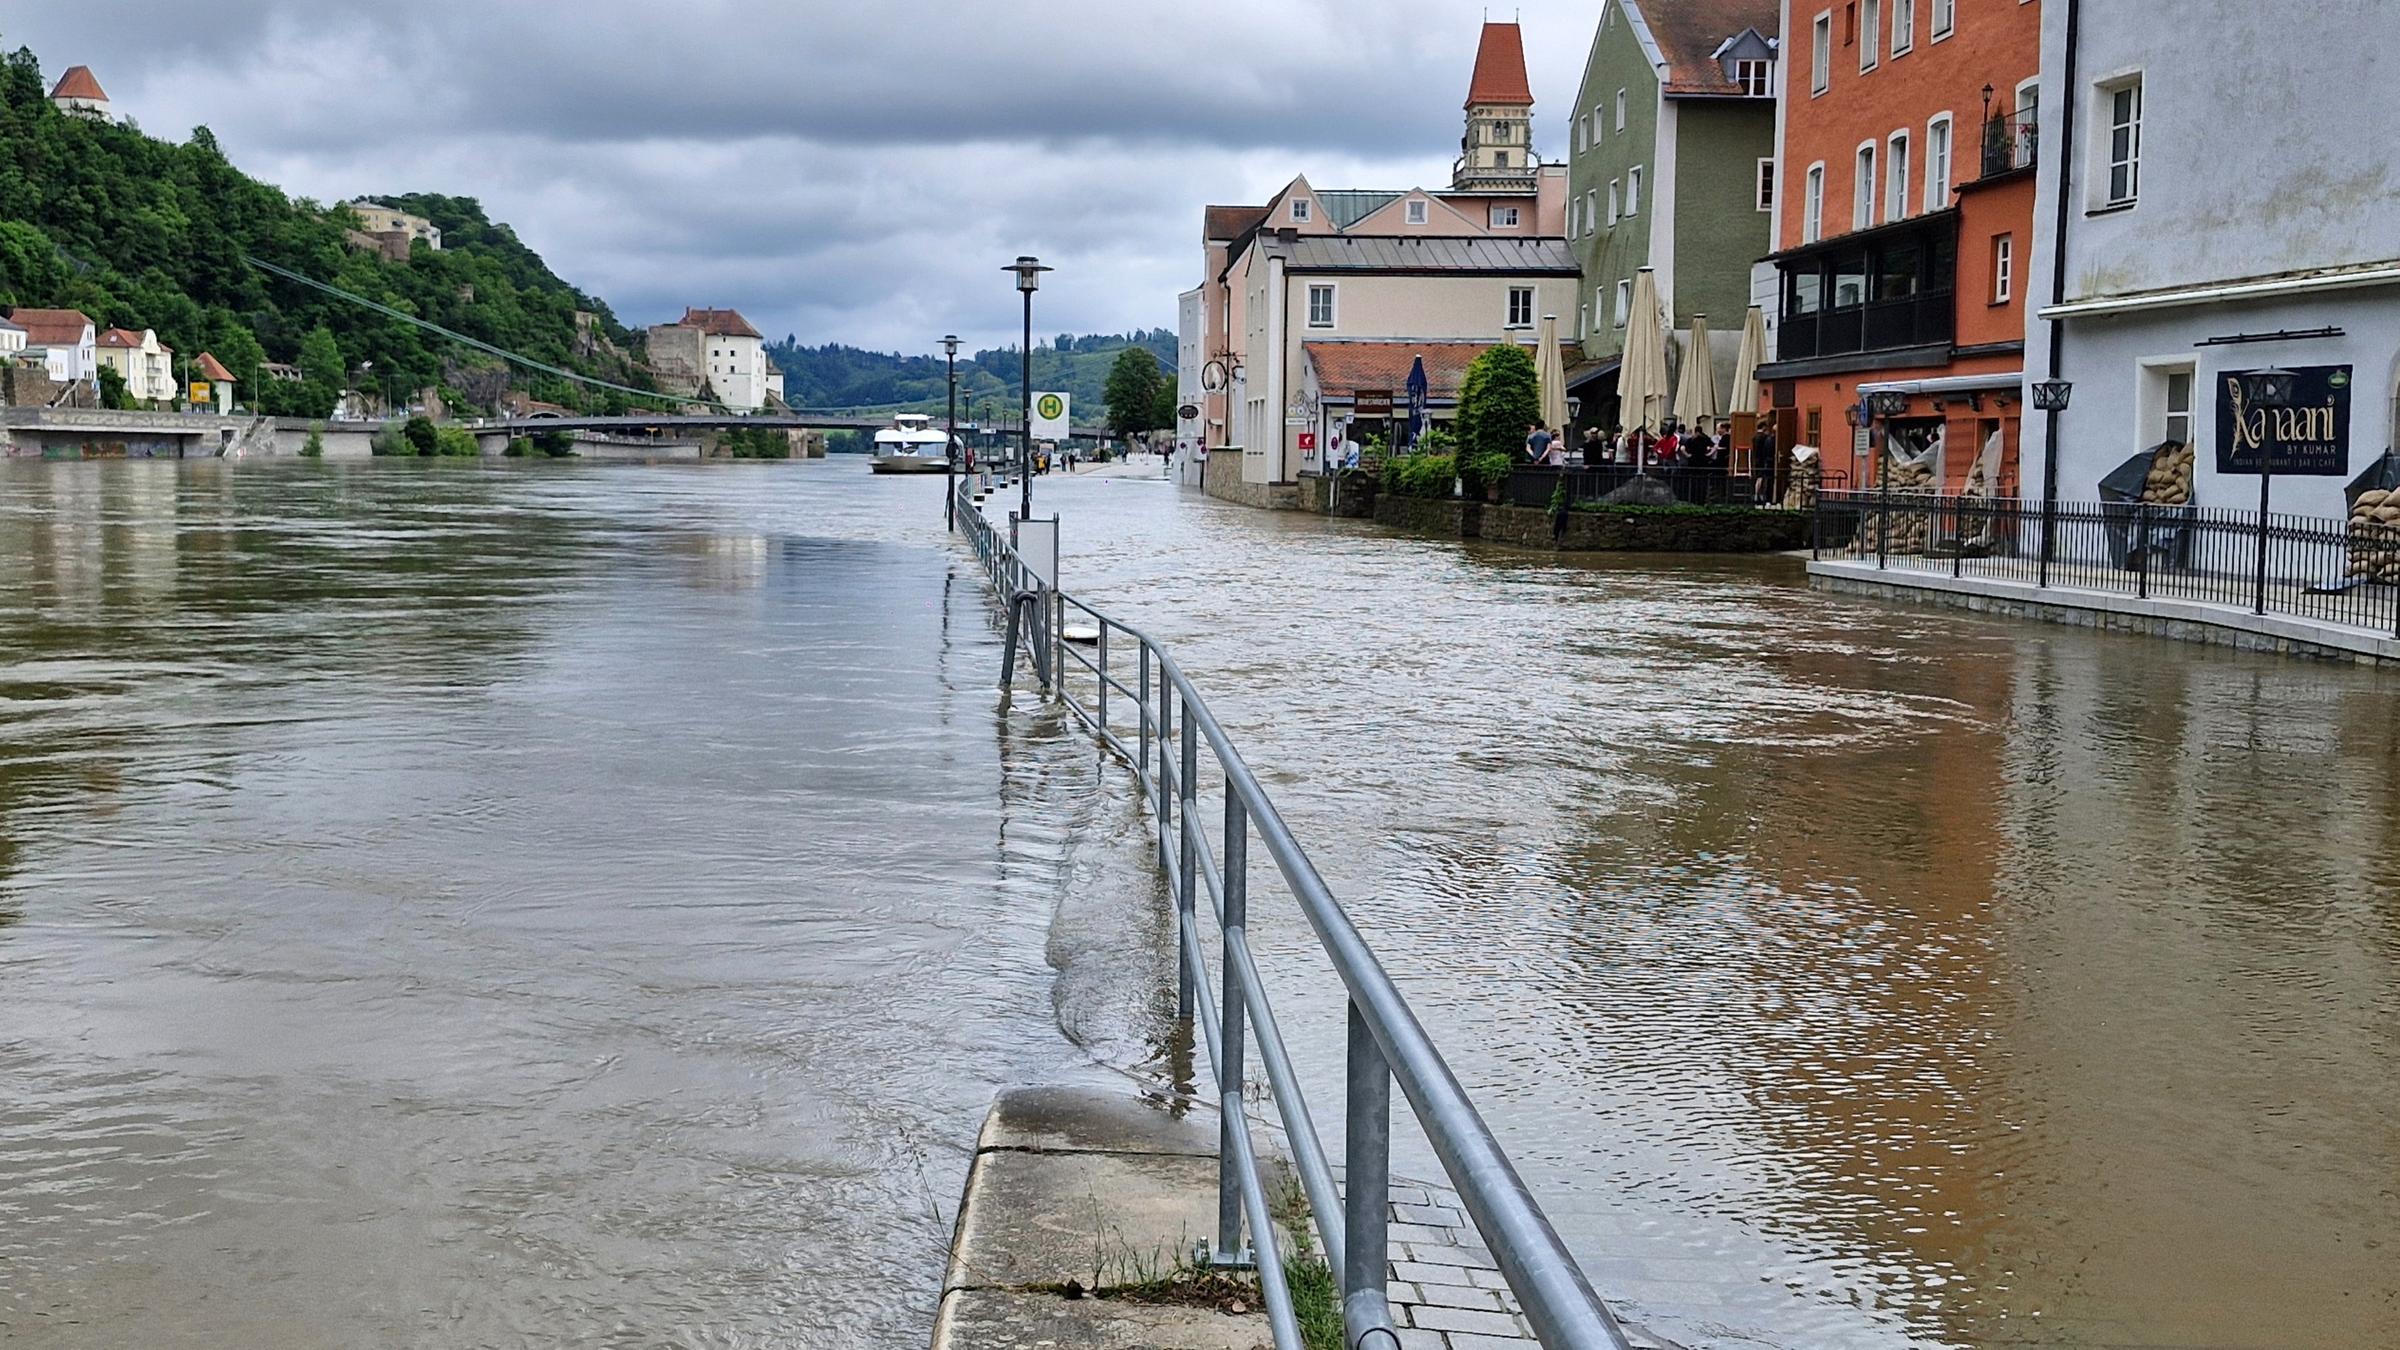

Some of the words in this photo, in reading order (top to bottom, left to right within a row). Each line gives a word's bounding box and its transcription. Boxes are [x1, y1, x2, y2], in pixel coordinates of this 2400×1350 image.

[1044, 399, 1057, 413] H
[2287, 444, 2298, 455] BY
[2303, 444, 2336, 455] KUMAR
